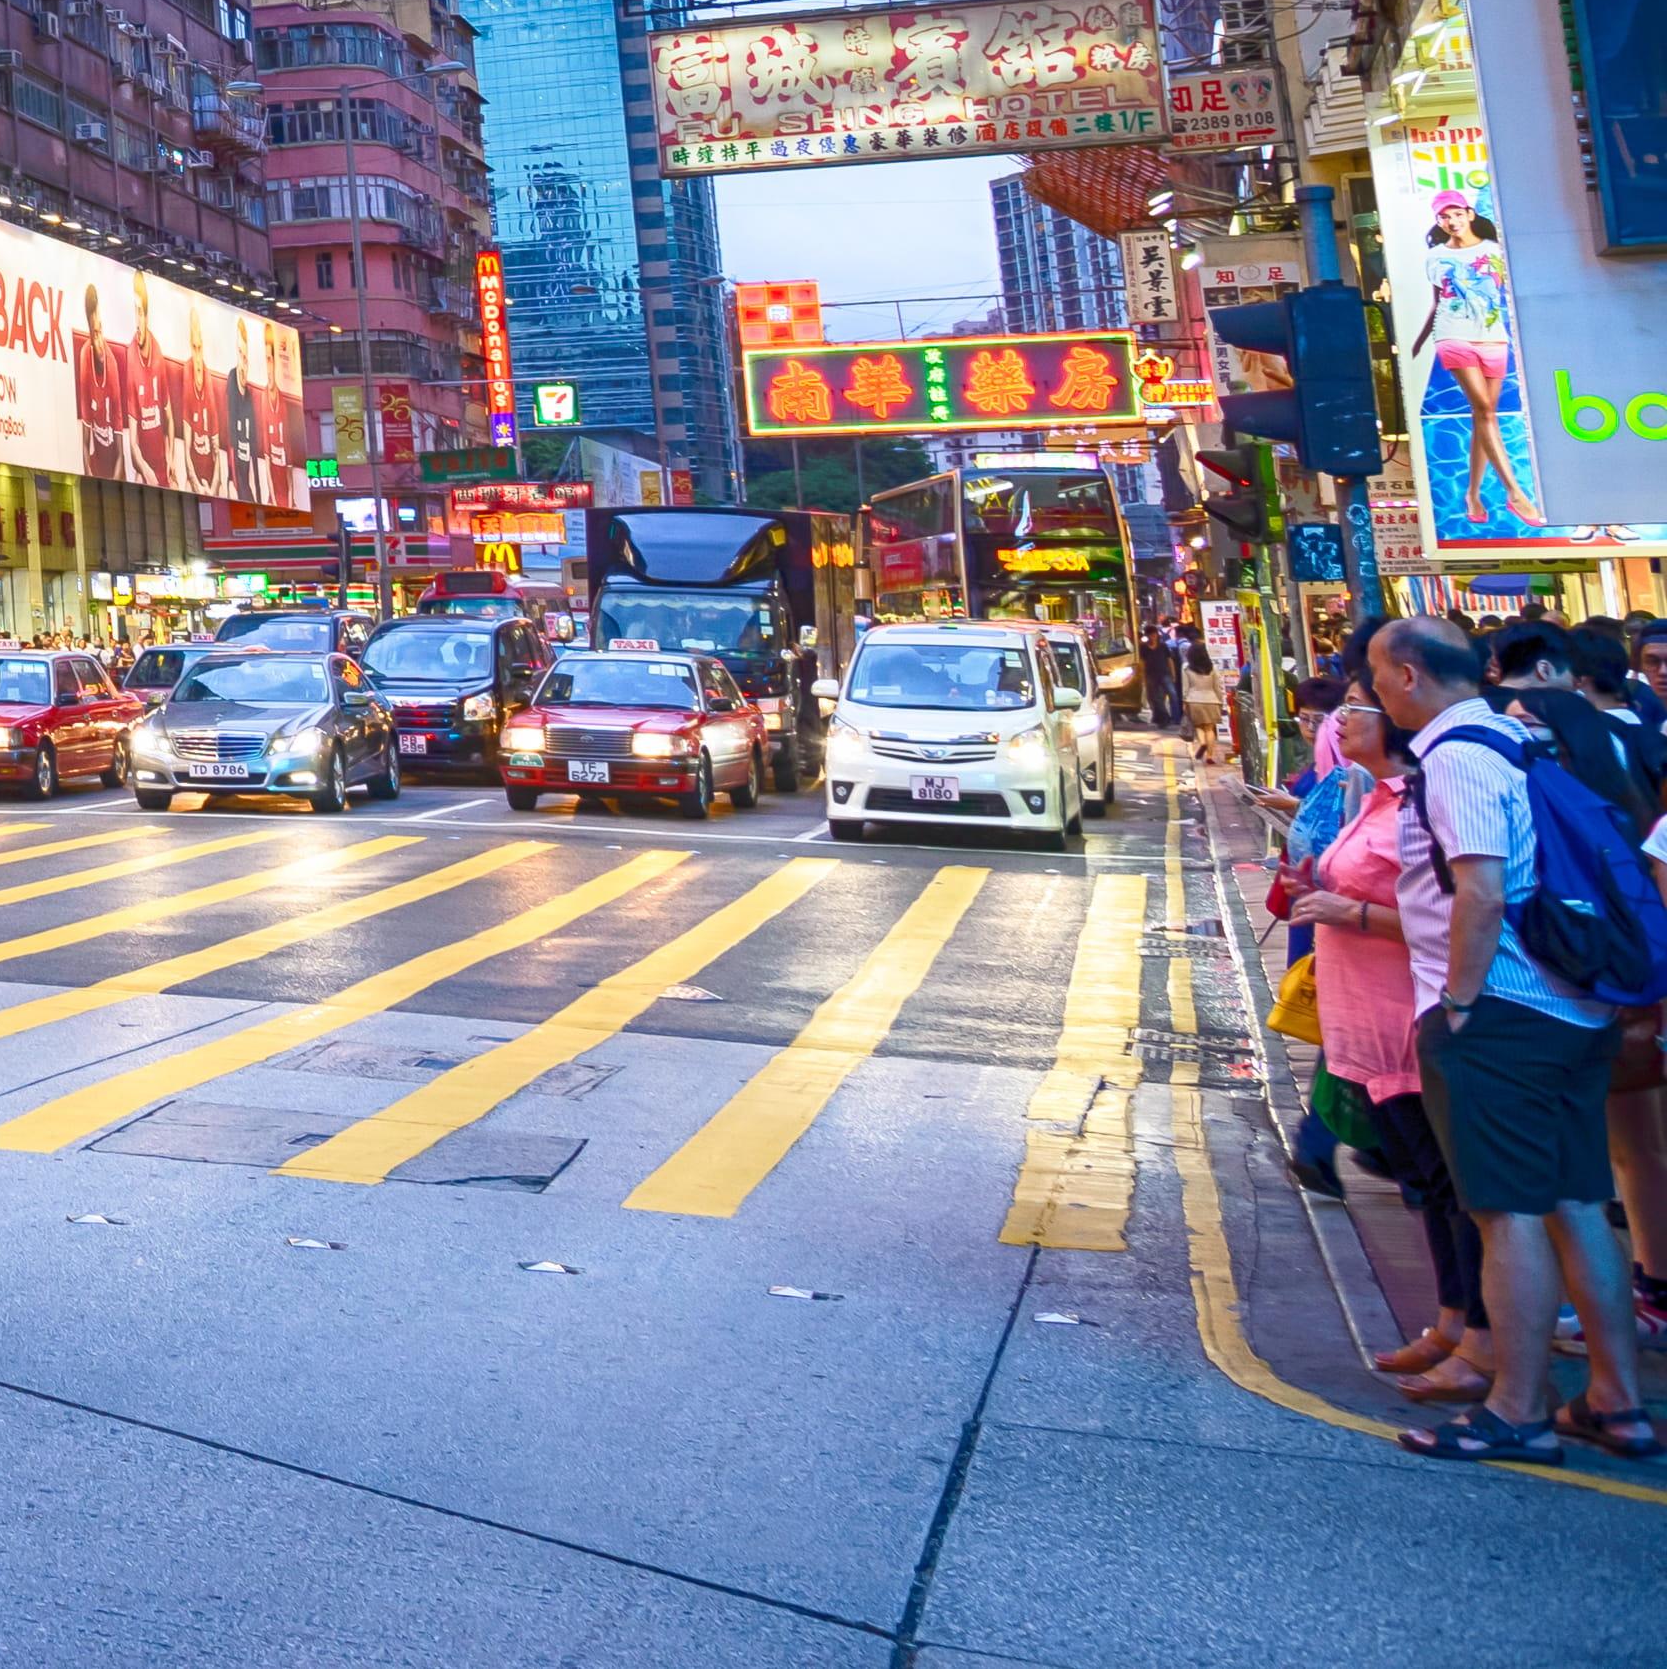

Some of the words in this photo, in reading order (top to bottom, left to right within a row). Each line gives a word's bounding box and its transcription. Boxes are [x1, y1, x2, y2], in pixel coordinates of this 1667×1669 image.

[1170, 79, 1230, 113] 知足
[677, 117, 739, 144] FU
[778, 100, 924, 133] SHING
[965, 84, 1141, 123] HOTEL
[1190, 115, 1230, 131] 2389
[1234, 111, 1275, 128] 8108
[671, 143, 764, 167] 時鐘特平
[770, 133, 861, 158] 過夜優惠
[868, 126, 968, 152] 豪華裝修
[1120, 109, 1155, 133] 1/F
[479, 276, 509, 407] McDonald's
[770, 346, 1118, 423] 南華藥房
[382, 393, 412, 420] 25
[192, 633, 214, 642] TAXI
[612, 640, 655, 650] TAXI
[192, 764, 208, 774] TD
[212, 765, 245, 775] 8786
[918, 788, 953, 799] 8180
[924, 777, 945, 788] MJ
